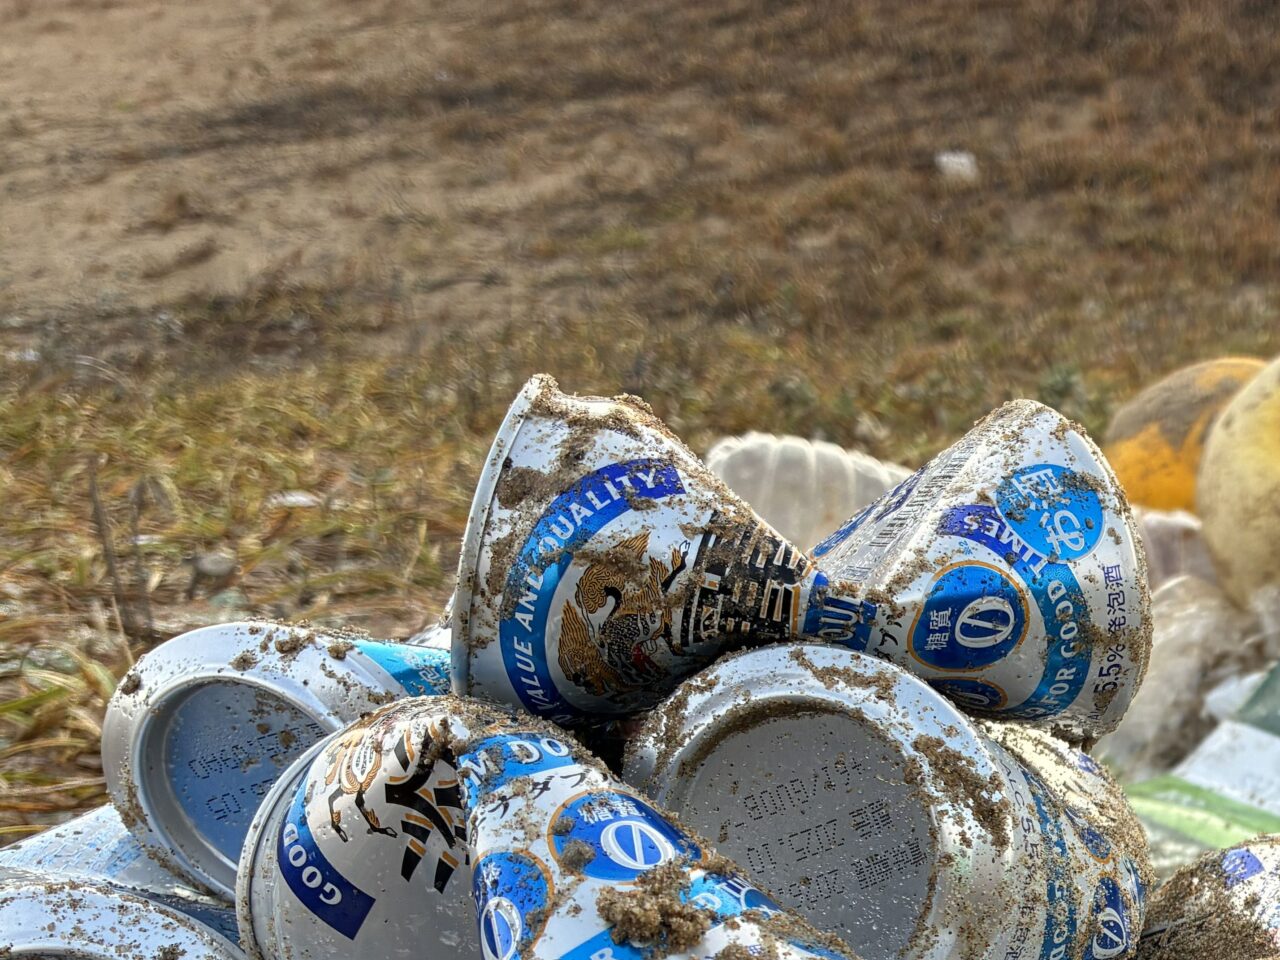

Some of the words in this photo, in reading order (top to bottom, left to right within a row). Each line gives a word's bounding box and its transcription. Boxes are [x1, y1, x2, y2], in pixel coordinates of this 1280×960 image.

[537, 467, 658, 558] QUALITY
[962, 513, 1050, 580] TIMES
[521, 572, 546, 633] AND
[923, 606, 953, 651] 糖質
[1047, 578, 1079, 659] GOOD
[513, 640, 550, 711] VALUE
[1040, 665, 1077, 706] FOR
[283, 822, 343, 906] GOOD
